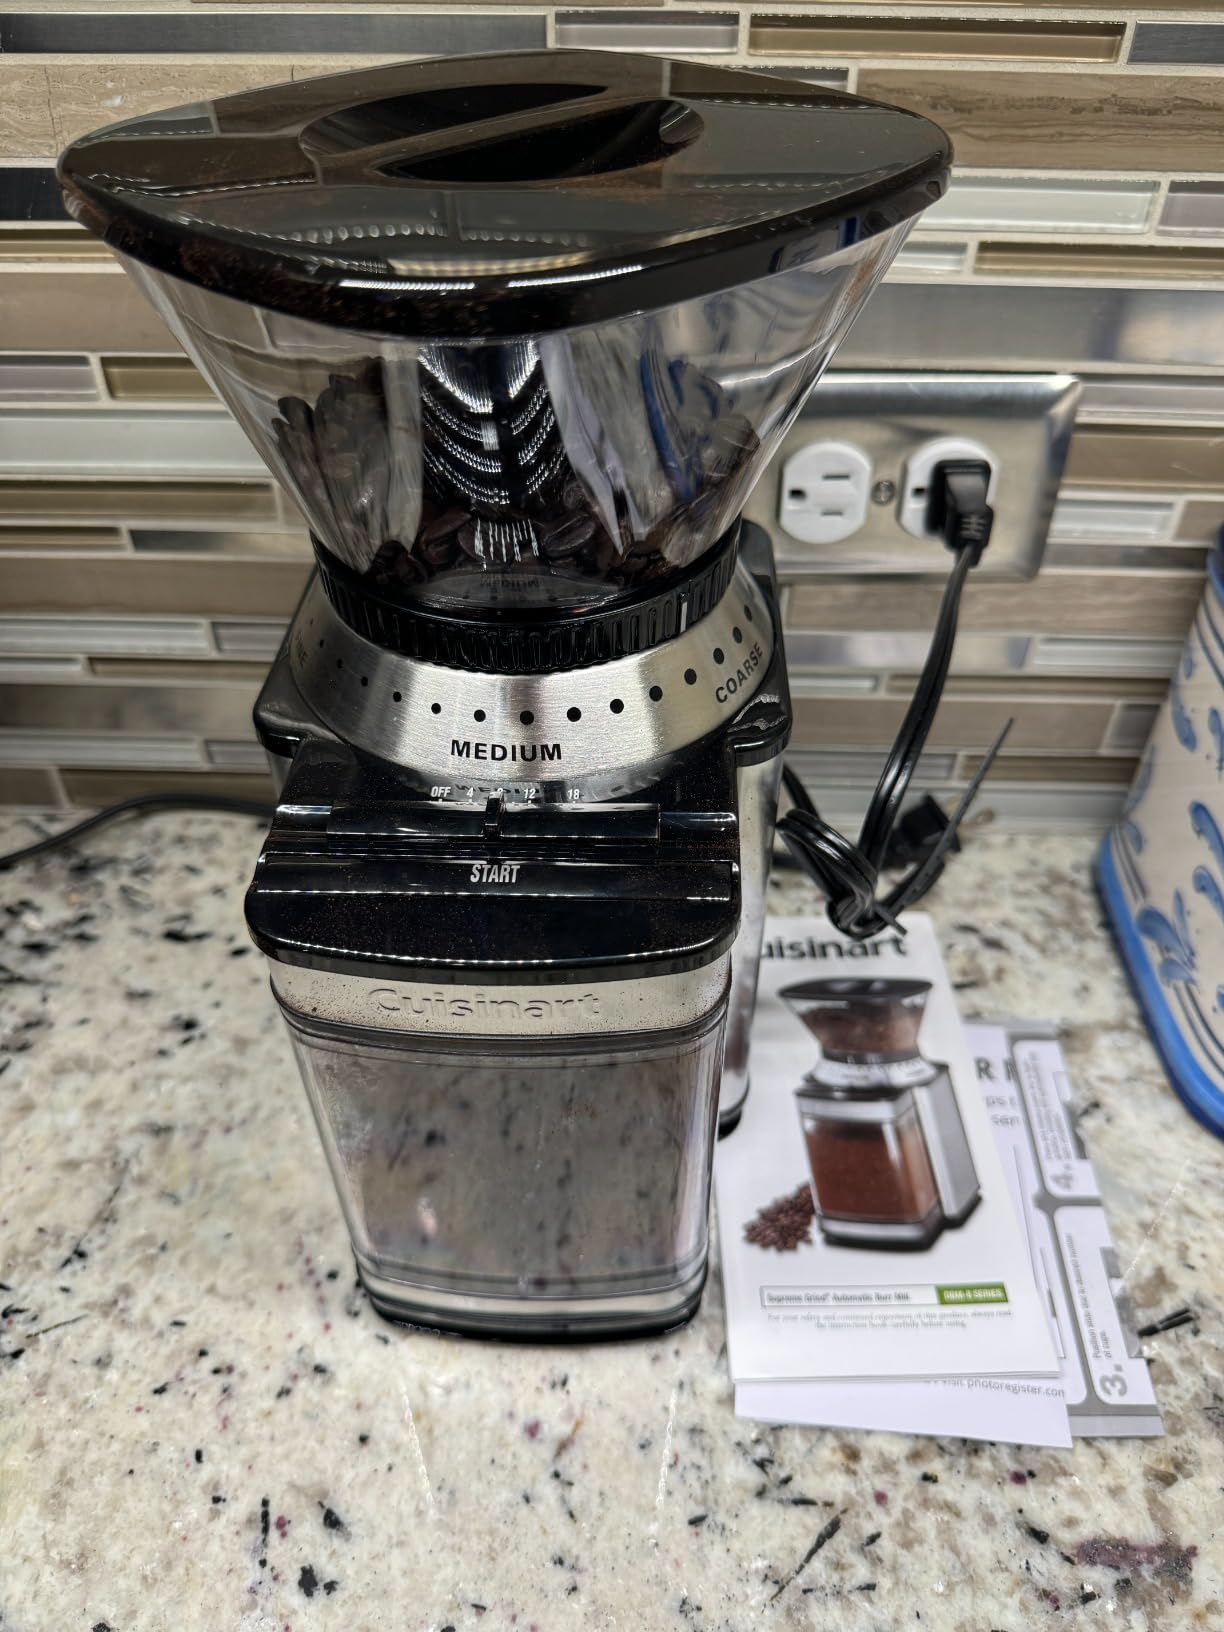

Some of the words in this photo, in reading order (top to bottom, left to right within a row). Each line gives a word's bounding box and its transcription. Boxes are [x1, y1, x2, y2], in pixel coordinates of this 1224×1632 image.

[715, 641, 763, 703] COARSE
[451, 739, 562, 762] MEDIUM
[431, 786, 451, 798] OFF
[466, 787, 474, 798] 4
[524, 788, 536, 799] 12
[568, 789, 580, 800] 18
[470, 864, 520, 883] START
[760, 936, 907, 960] uisinart
[368, 988, 600, 1019] Cuisinart
